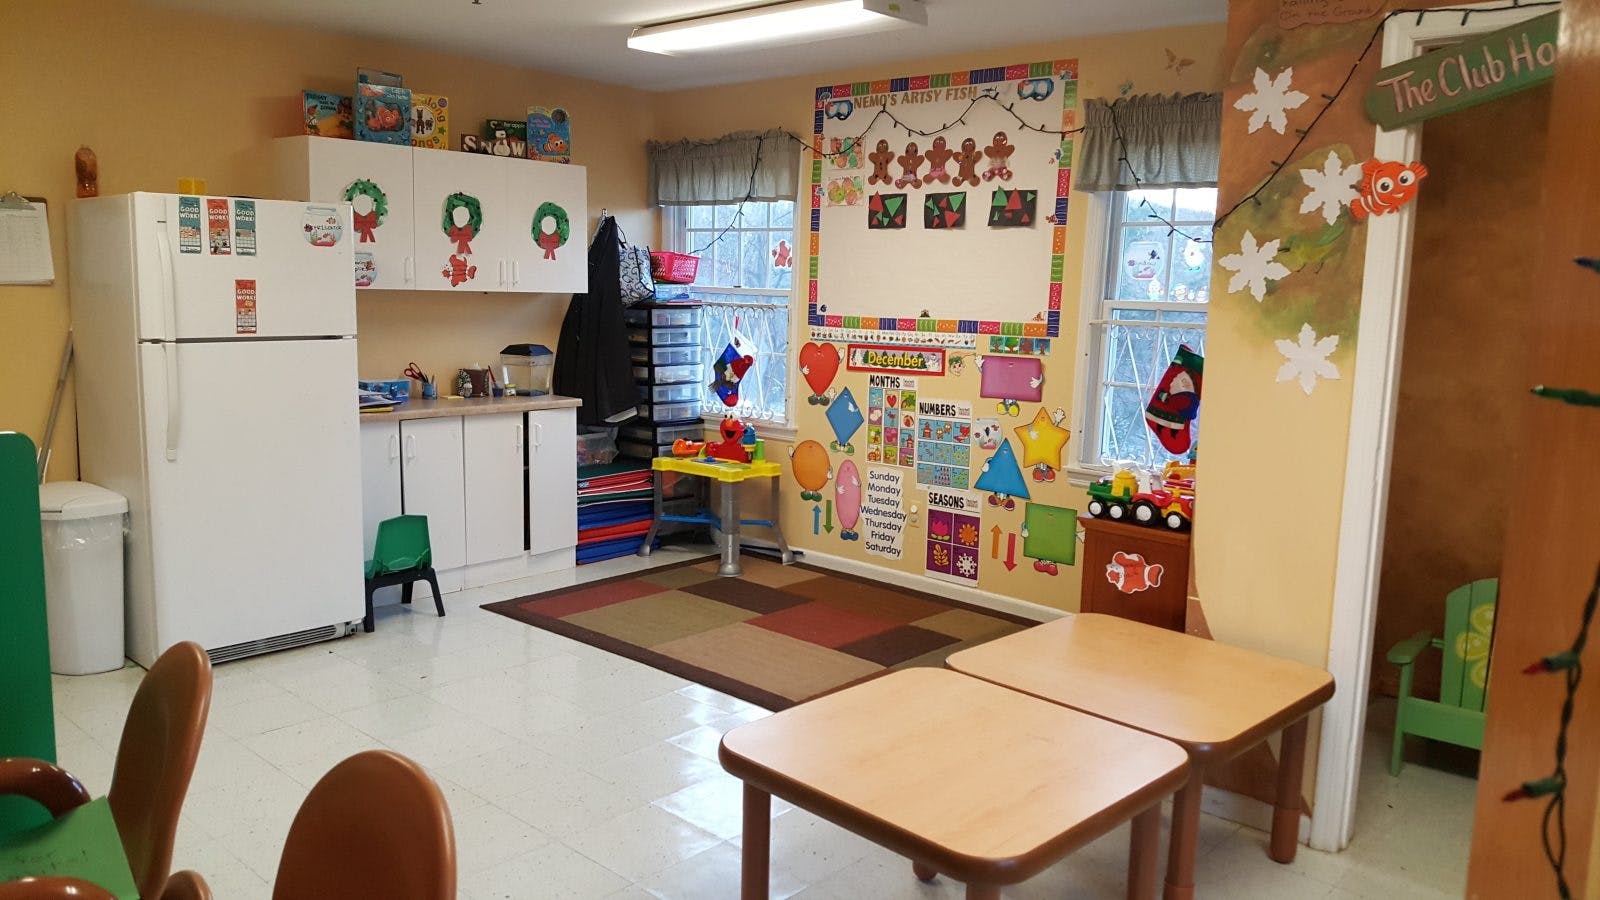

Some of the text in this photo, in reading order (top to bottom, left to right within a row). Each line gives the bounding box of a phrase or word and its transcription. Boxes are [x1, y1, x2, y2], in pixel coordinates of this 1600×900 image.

[1376, 70, 1437, 113] The
[1438, 45, 1506, 97] Club
[853, 86, 978, 109] NEMO'S ARTSY FISH
[868, 351, 924, 367] December
[869, 375, 901, 388] MONTHS
[919, 402, 956, 417] NUMBERS
[869, 470, 900, 484] Sunday
[867, 482, 901, 497] Monday
[868, 494, 900, 509] Tuesday
[928, 492, 965, 509] SEASONS
[861, 505, 907, 522] Wednesday
[865, 517, 902, 533] Thursday
[871, 531, 895, 544] Friday
[865, 541, 902, 557] Saturday
